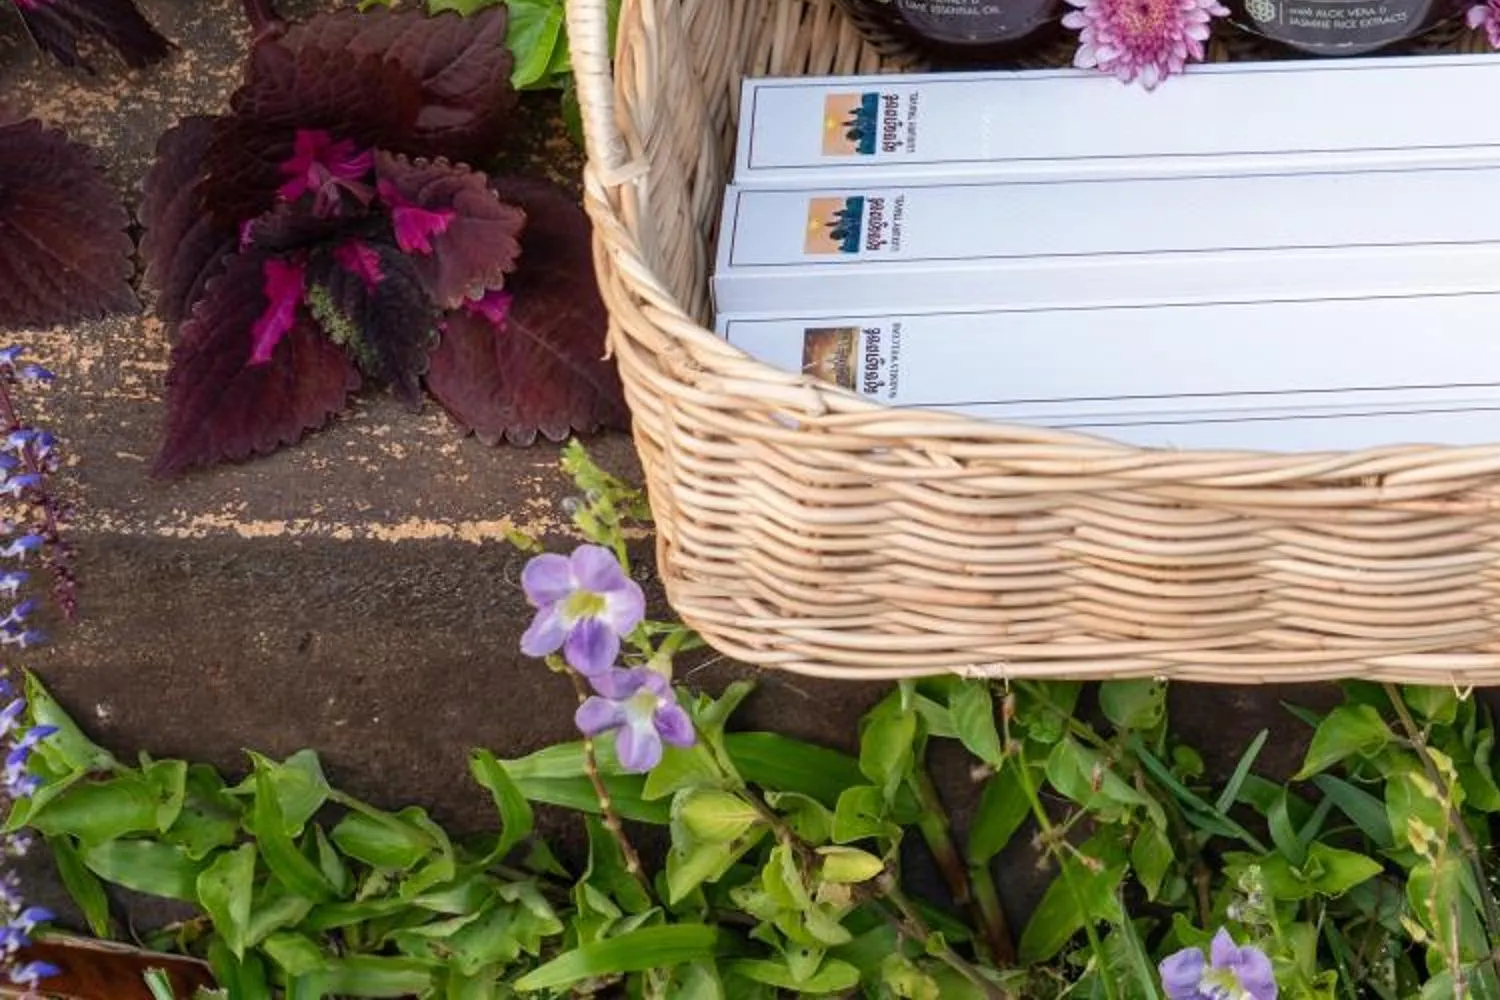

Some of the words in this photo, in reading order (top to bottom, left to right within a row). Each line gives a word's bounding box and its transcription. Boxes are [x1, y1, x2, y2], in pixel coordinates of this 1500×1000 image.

[1316, 9, 1344, 18] ALOE
[1347, 7, 1375, 17] VERA
[1333, 18, 1357, 29] RICE
